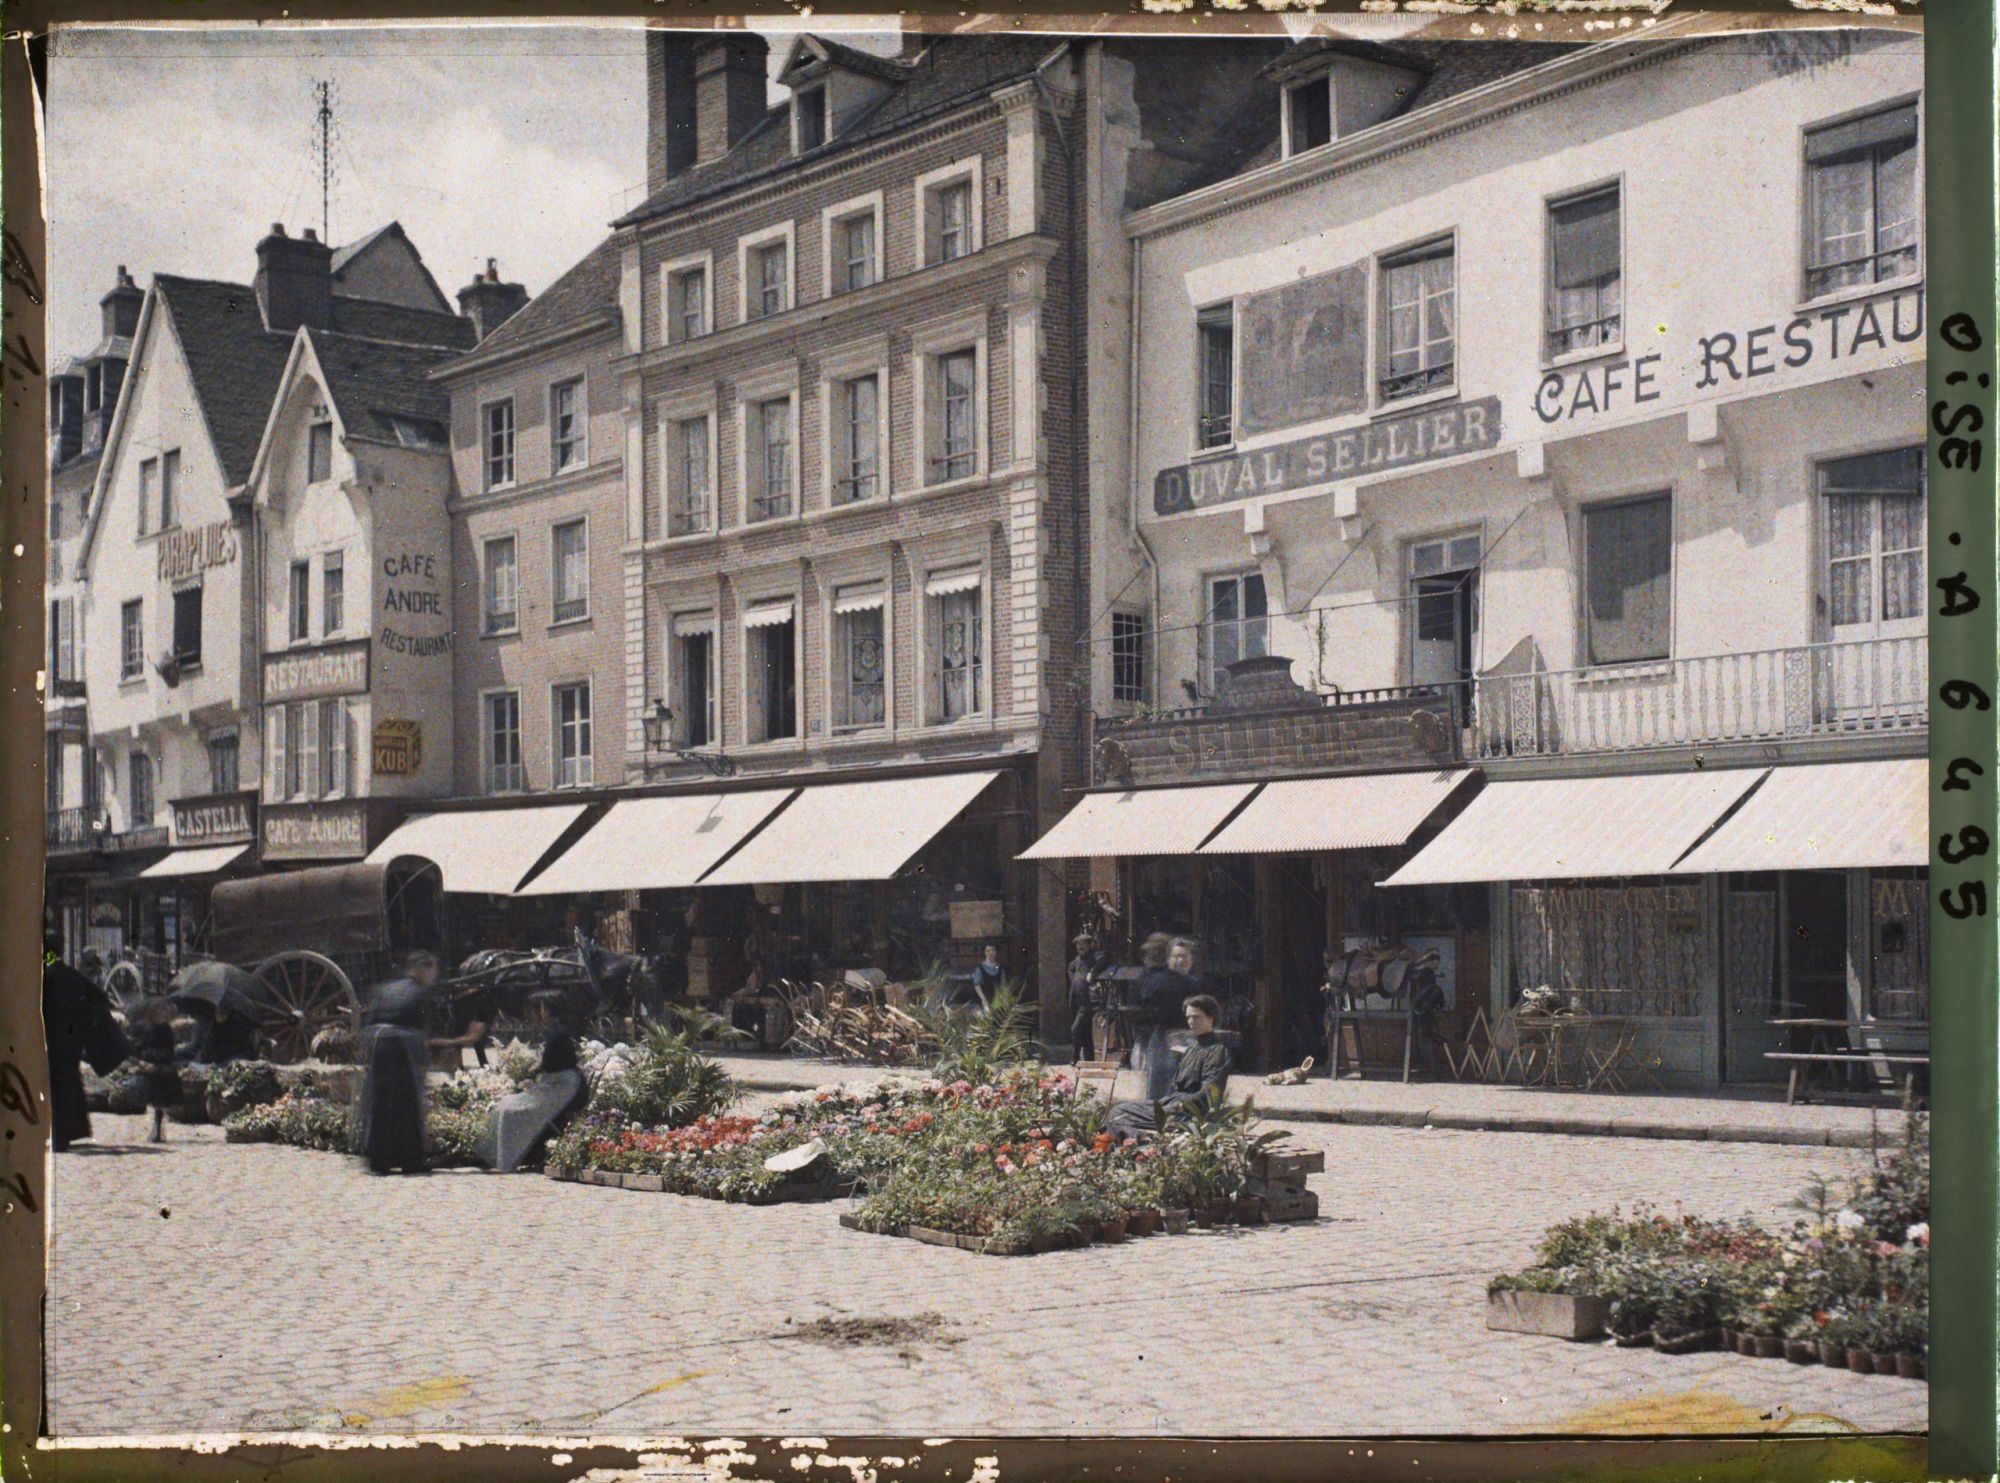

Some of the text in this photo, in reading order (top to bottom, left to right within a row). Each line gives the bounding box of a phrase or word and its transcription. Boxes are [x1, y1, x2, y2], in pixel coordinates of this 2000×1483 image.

[1695, 290, 1924, 390] RESTAU
[1162, 405, 1489, 507] DUVAL SELLIER
[380, 627, 453, 657] RESTAURANT
[264, 652, 366, 693] RESTAURANT
[375, 749, 406, 772] KUB
[176, 804, 249, 836] CASTELLA
